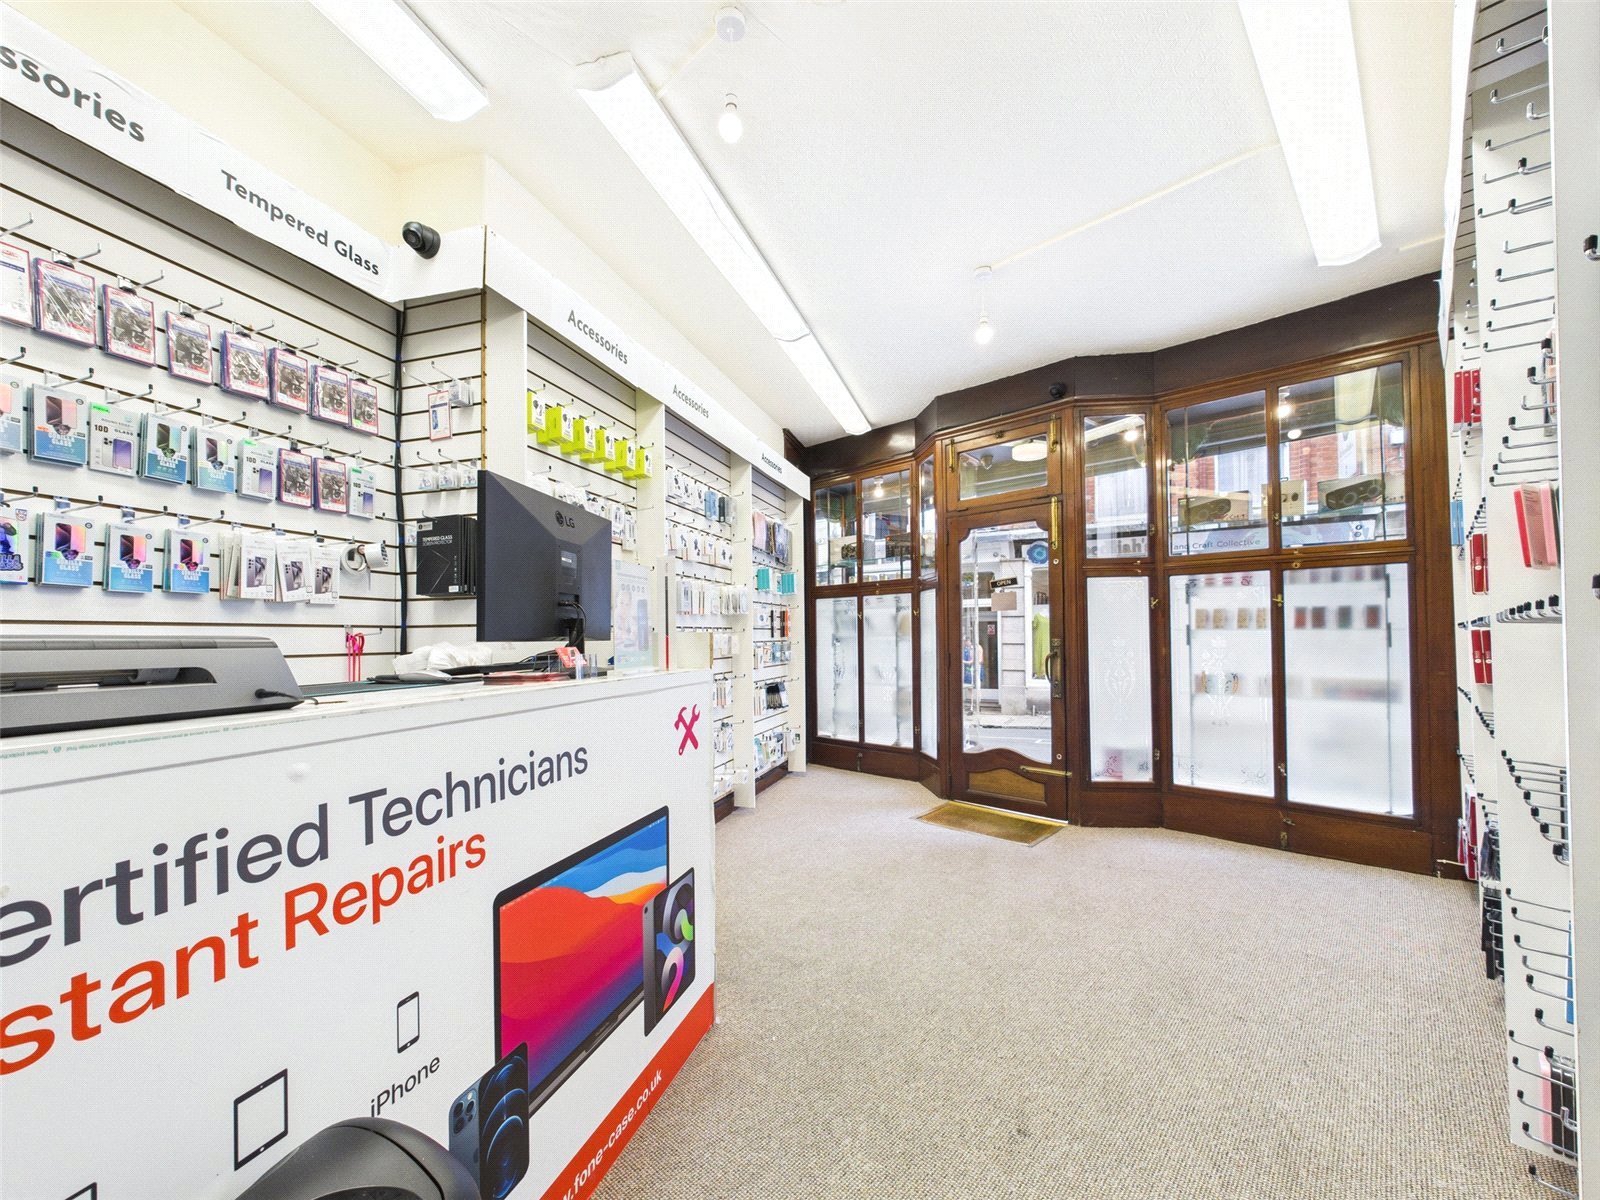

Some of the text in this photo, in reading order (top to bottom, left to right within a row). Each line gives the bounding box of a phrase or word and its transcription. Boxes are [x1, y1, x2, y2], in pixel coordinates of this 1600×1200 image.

[0, 46, 145, 142] ssories
[221, 169, 380, 276] Tempered Glass
[567, 309, 628, 365] Accessories
[672, 384, 709, 419] Accessories
[761, 452, 782, 474] Accessories
[564, 516, 575, 528] LG
[1192, 541, 1213, 549] Craft
[1216, 539, 1261, 548] Collective
[996, 579, 1011, 587] OPEN
[0, 747, 589, 968] ertified Technicians
[0, 833, 487, 1077] stant Repairs
[371, 1057, 440, 1118] iPhone
